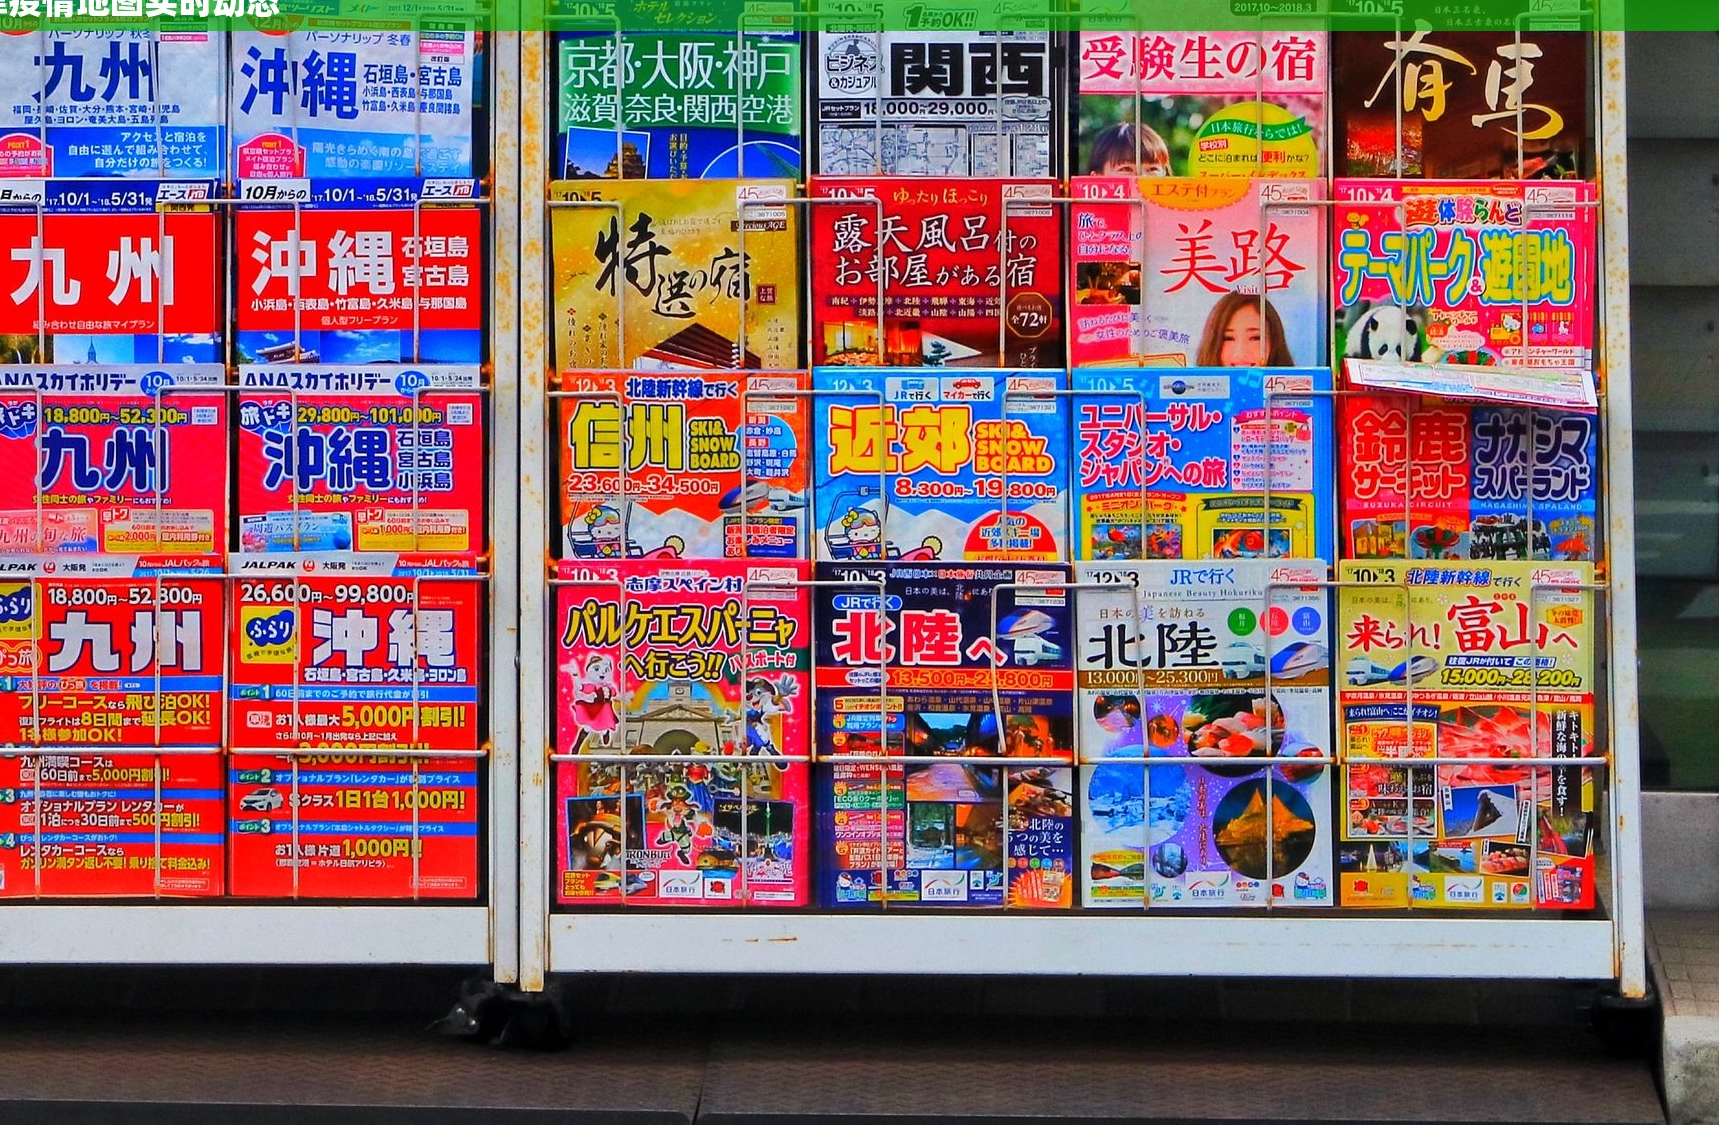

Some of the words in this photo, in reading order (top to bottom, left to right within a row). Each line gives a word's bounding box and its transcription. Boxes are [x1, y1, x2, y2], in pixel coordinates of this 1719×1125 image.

[32, 41, 160, 105] 九州
[240, 47, 360, 120] 沖縄
[889, 42, 1046, 97] 関西
[1081, 35, 1317, 82] 受験生の宿
[1363, 18, 1565, 140] 有馬
[1151, 183, 1237, 198] エステ付プラン
[10, 235, 175, 307] 九州
[250, 229, 396, 296] 沖縄
[593, 212, 752, 319] 特選の宿
[1160, 218, 1307, 297] 美路
[1480, 228, 1576, 306] 遊園地
[321, 315, 399, 325] 個人型フリープラン
[626, 378, 737, 399] 北陸新幹線で行く
[42, 428, 169, 492] 九州
[263, 427, 392, 491] 沖縄
[570, 403, 686, 473] 信州
[689, 436, 735, 454] SNOW
[829, 405, 971, 476] 近郊
[1353, 411, 1468, 464] 鈴鹿
[397, 471, 452, 491] 小浜島
[1353, 467, 1468, 501] サーキット
[1363, 501, 1404, 509] SUZUKA
[1411, 501, 1452, 509] CIRCUIT
[1143, 589, 1177, 599] Japanese
[1181, 589, 1210, 599] Beauty
[1214, 589, 1263, 598] Hokuriku
[49, 610, 201, 673] 九州
[312, 608, 456, 668] 沖縄
[564, 602, 797, 648] パルケエスパーニャ
[832, 609, 1007, 667] 北陸へ
[1087, 622, 1220, 669] 北陸
[665, 884, 699, 895] 日本旅行
[1190, 888, 1225, 898] 日本旅行
